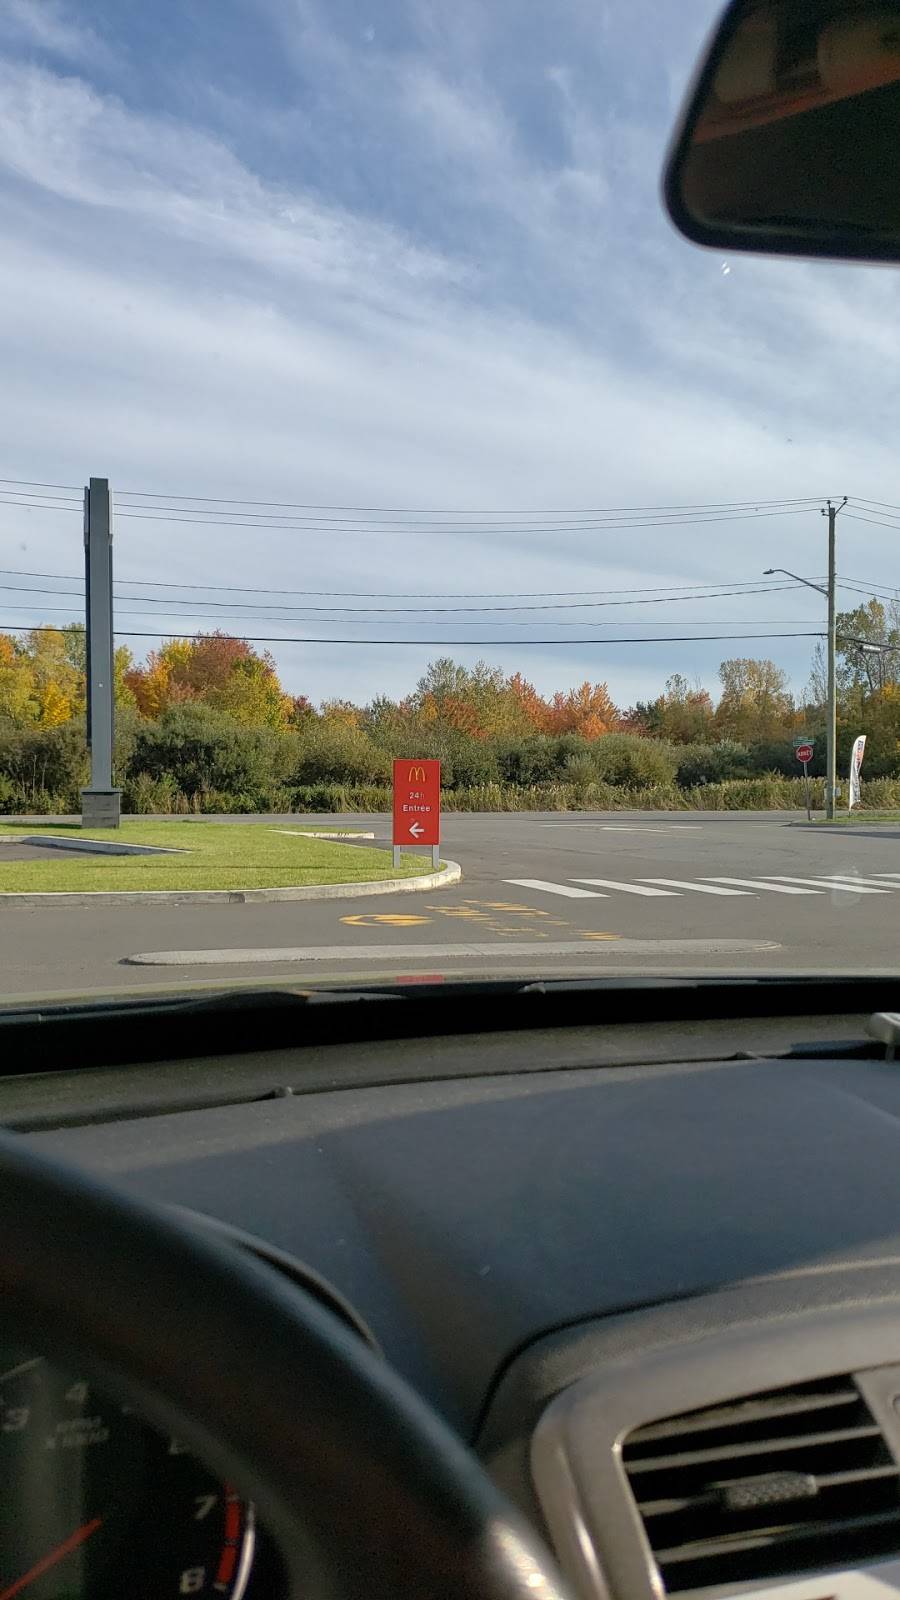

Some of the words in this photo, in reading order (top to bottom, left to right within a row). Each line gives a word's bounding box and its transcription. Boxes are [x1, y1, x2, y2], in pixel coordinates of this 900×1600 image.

[402, 803, 431, 812] Entrée
[65, 1382, 88, 1404] 4
[194, 1494, 218, 1519] 7
[179, 1566, 206, 1593] 8
